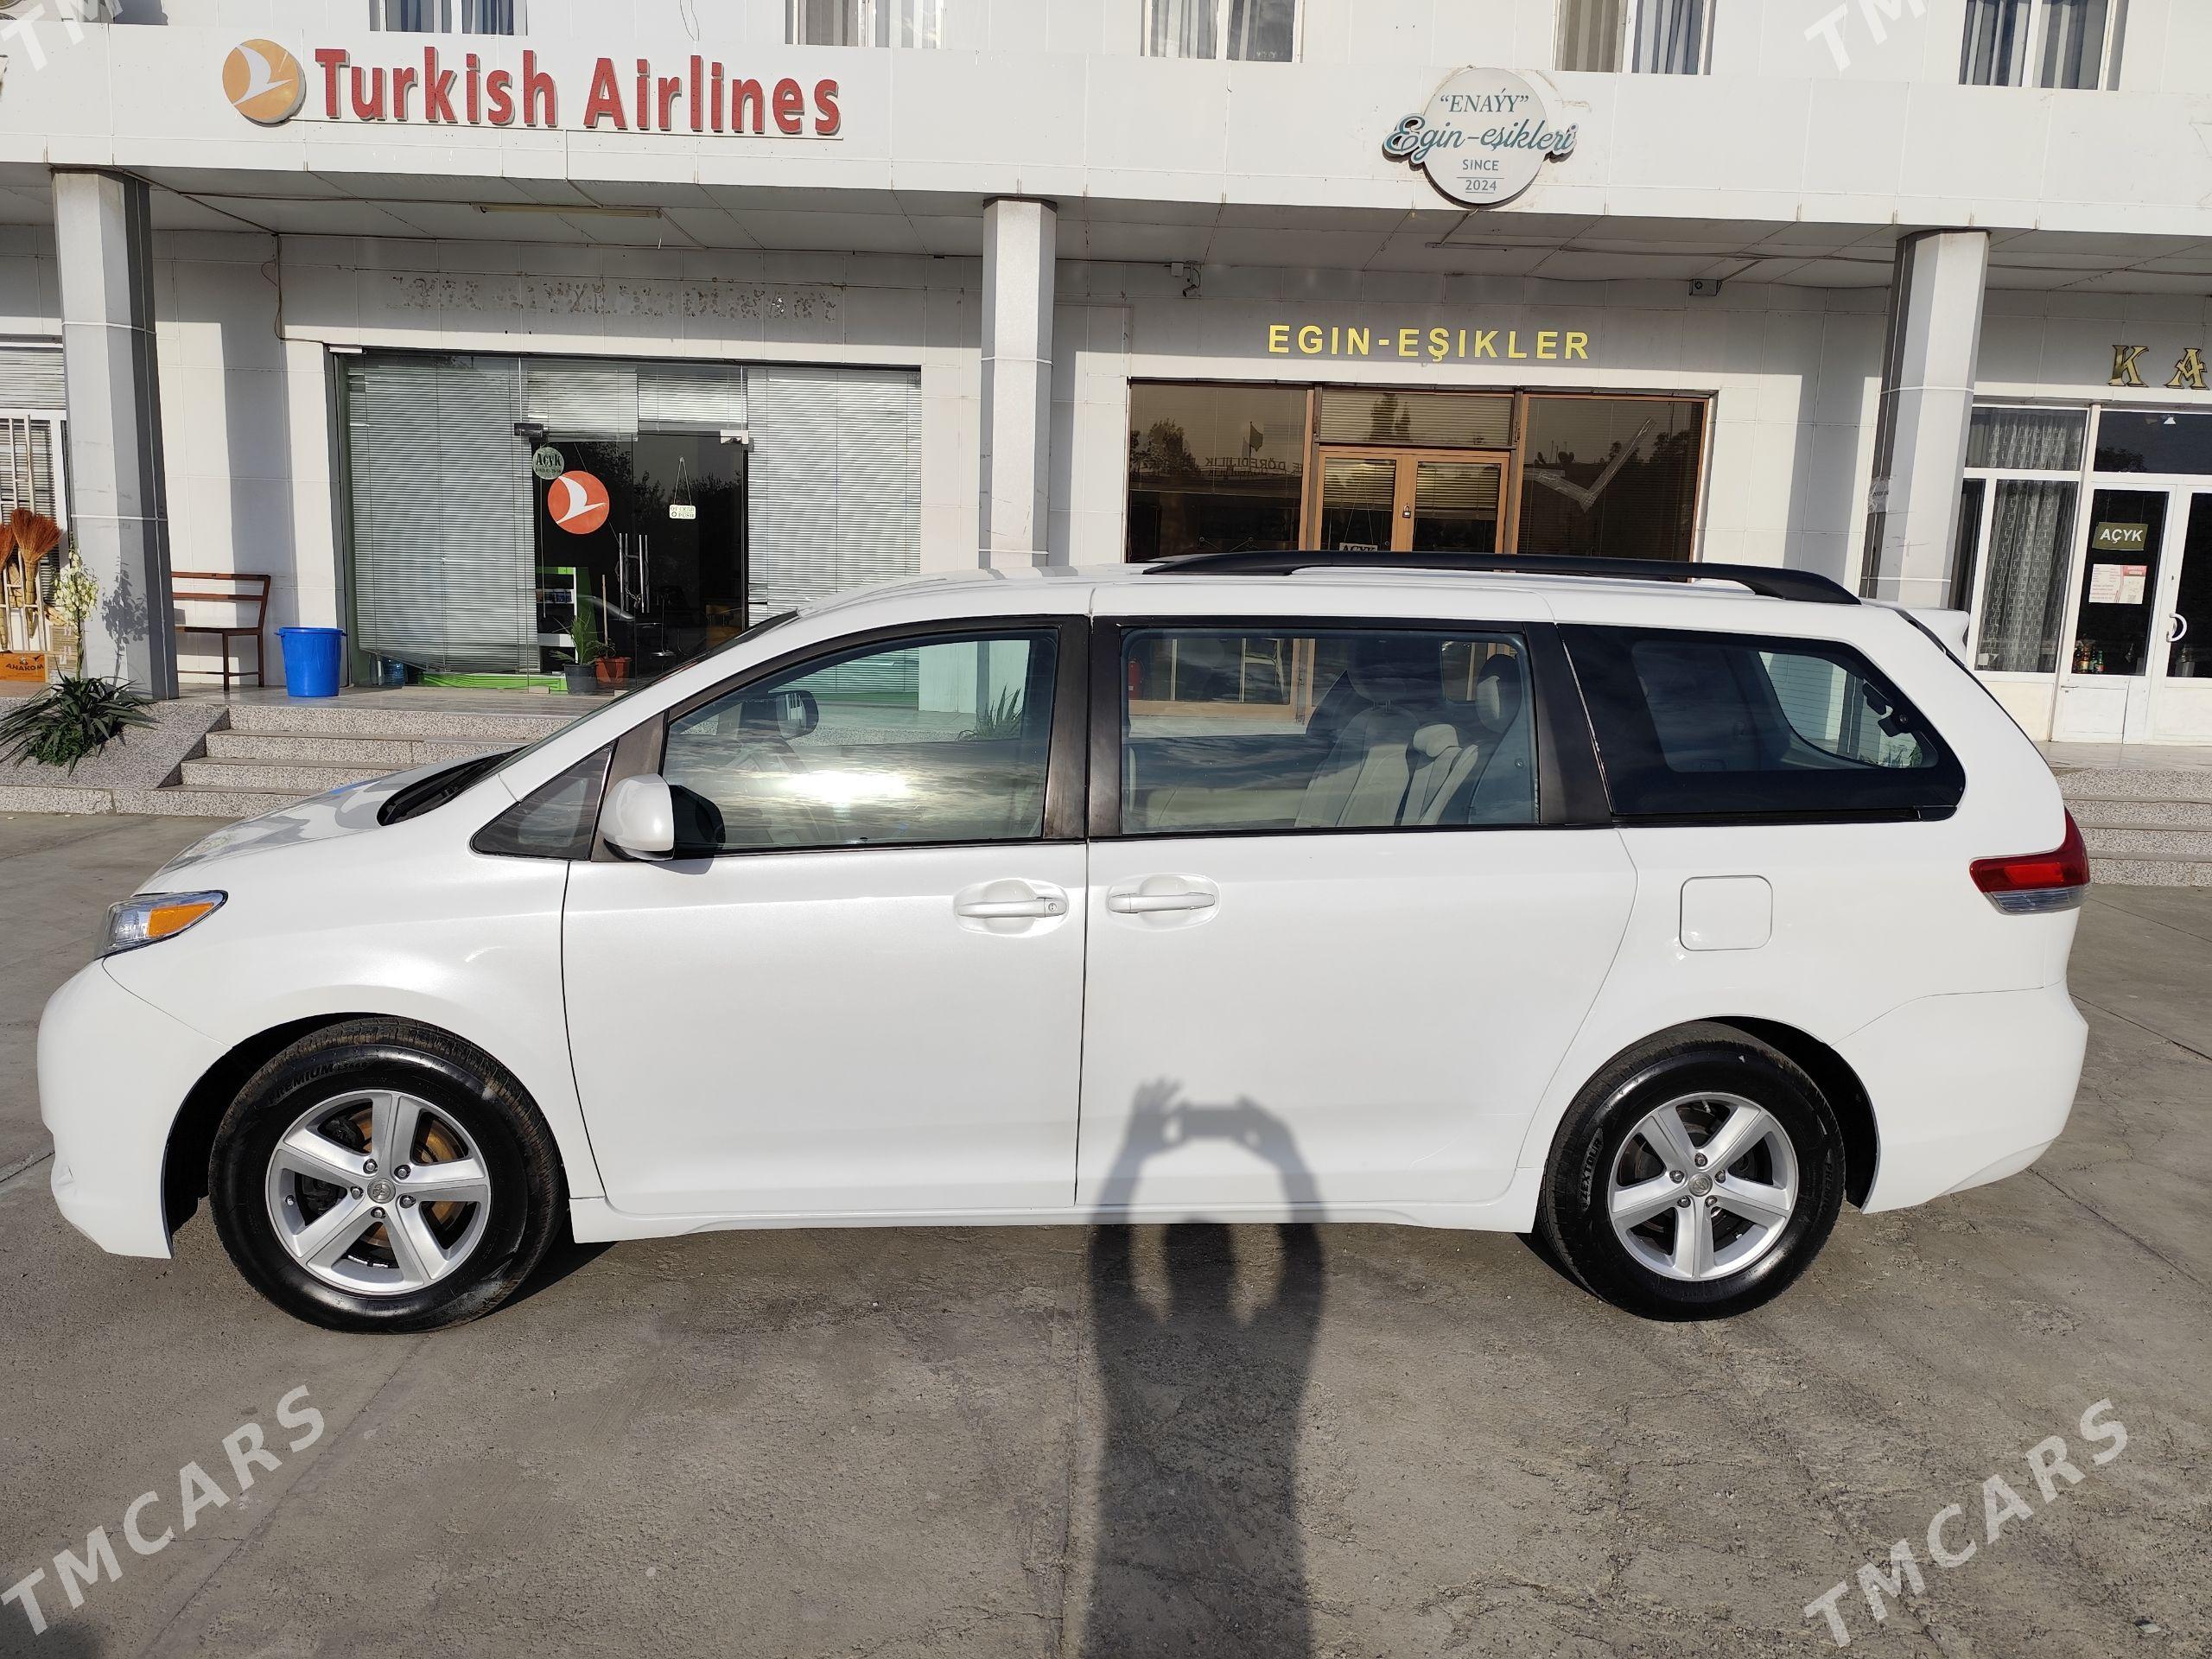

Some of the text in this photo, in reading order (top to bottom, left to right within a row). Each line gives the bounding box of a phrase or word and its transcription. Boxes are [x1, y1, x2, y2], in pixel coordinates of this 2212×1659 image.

[315, 47, 842, 136] Turkish Airlines
[1386, 116, 1578, 162] Egin-eşikleri
[1462, 159, 1499, 171] SINCE
[1465, 180, 1497, 191] 2024
[1268, 324, 1589, 362] EGIN-EŞIKLER
[2100, 528, 2143, 544] AÇYK
[1580, 1137, 1603, 1201] ZEXTOUR
